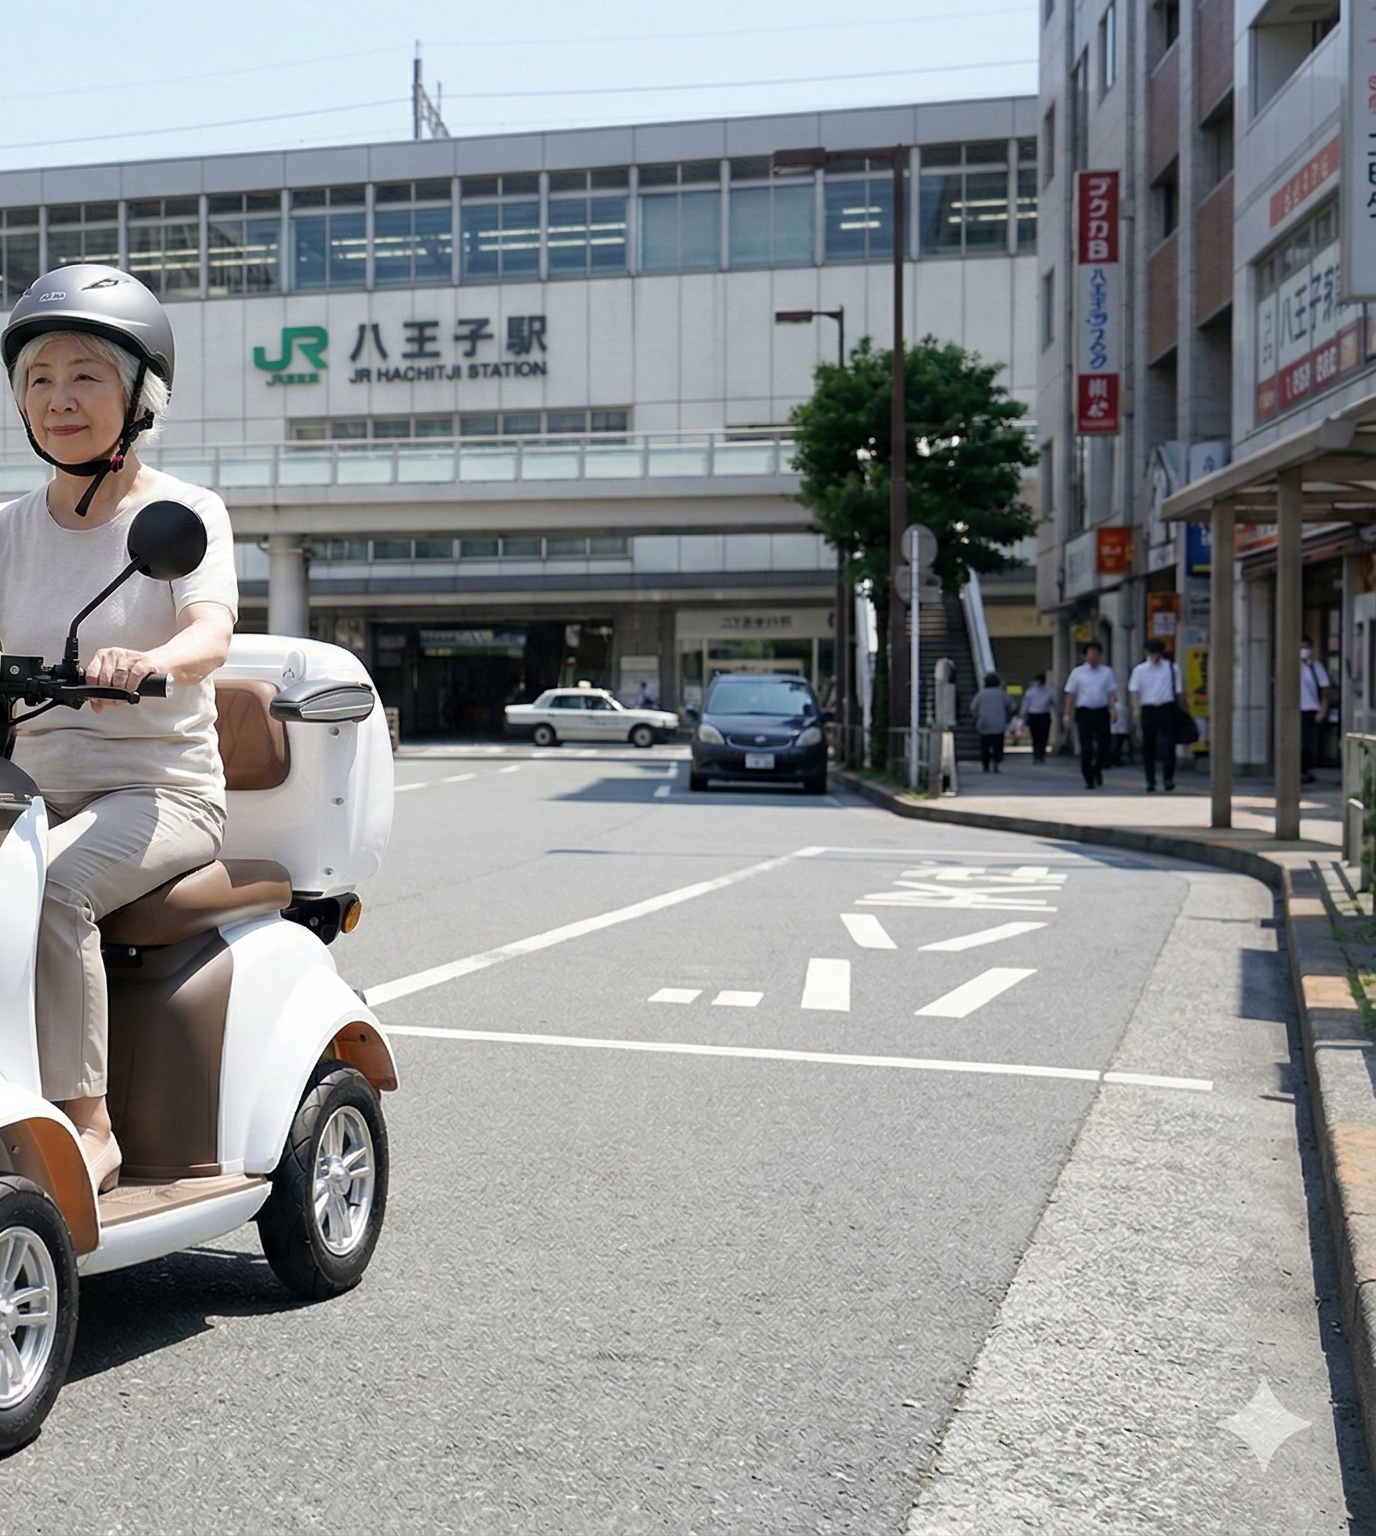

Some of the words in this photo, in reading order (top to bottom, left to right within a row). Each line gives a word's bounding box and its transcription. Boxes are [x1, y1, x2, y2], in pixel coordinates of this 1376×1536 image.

[253, 325, 329, 372] JR
[350, 315, 548, 362] 八王子駅
[349, 368, 371, 383] JR
[467, 360, 547, 379] STATION
